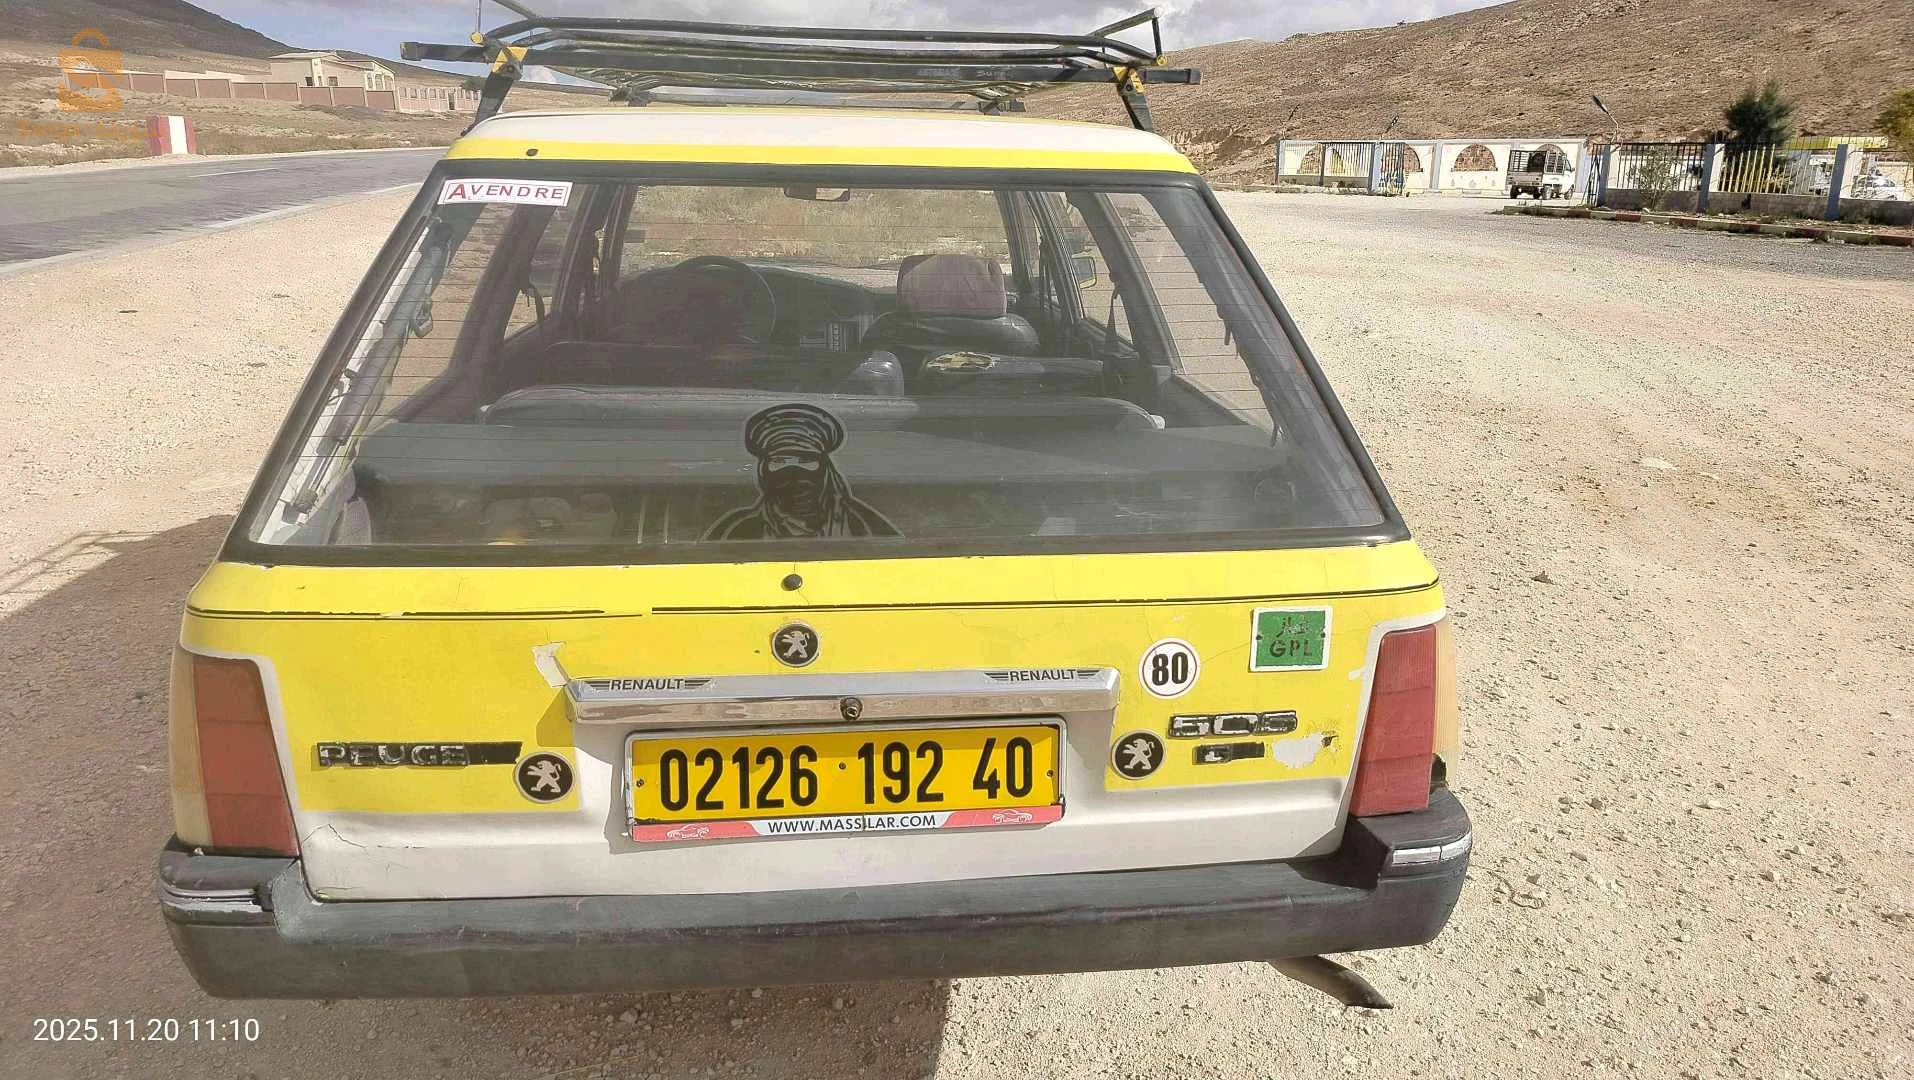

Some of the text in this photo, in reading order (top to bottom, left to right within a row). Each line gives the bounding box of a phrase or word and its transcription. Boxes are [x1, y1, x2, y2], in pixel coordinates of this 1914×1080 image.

[1269, 639, 1312, 658] GPL
[1008, 669, 1076, 682] RENAULT
[1151, 651, 1189, 686] 80
[610, 678, 684, 691] RENAULT
[659, 736, 1033, 812] 02126 192 40
